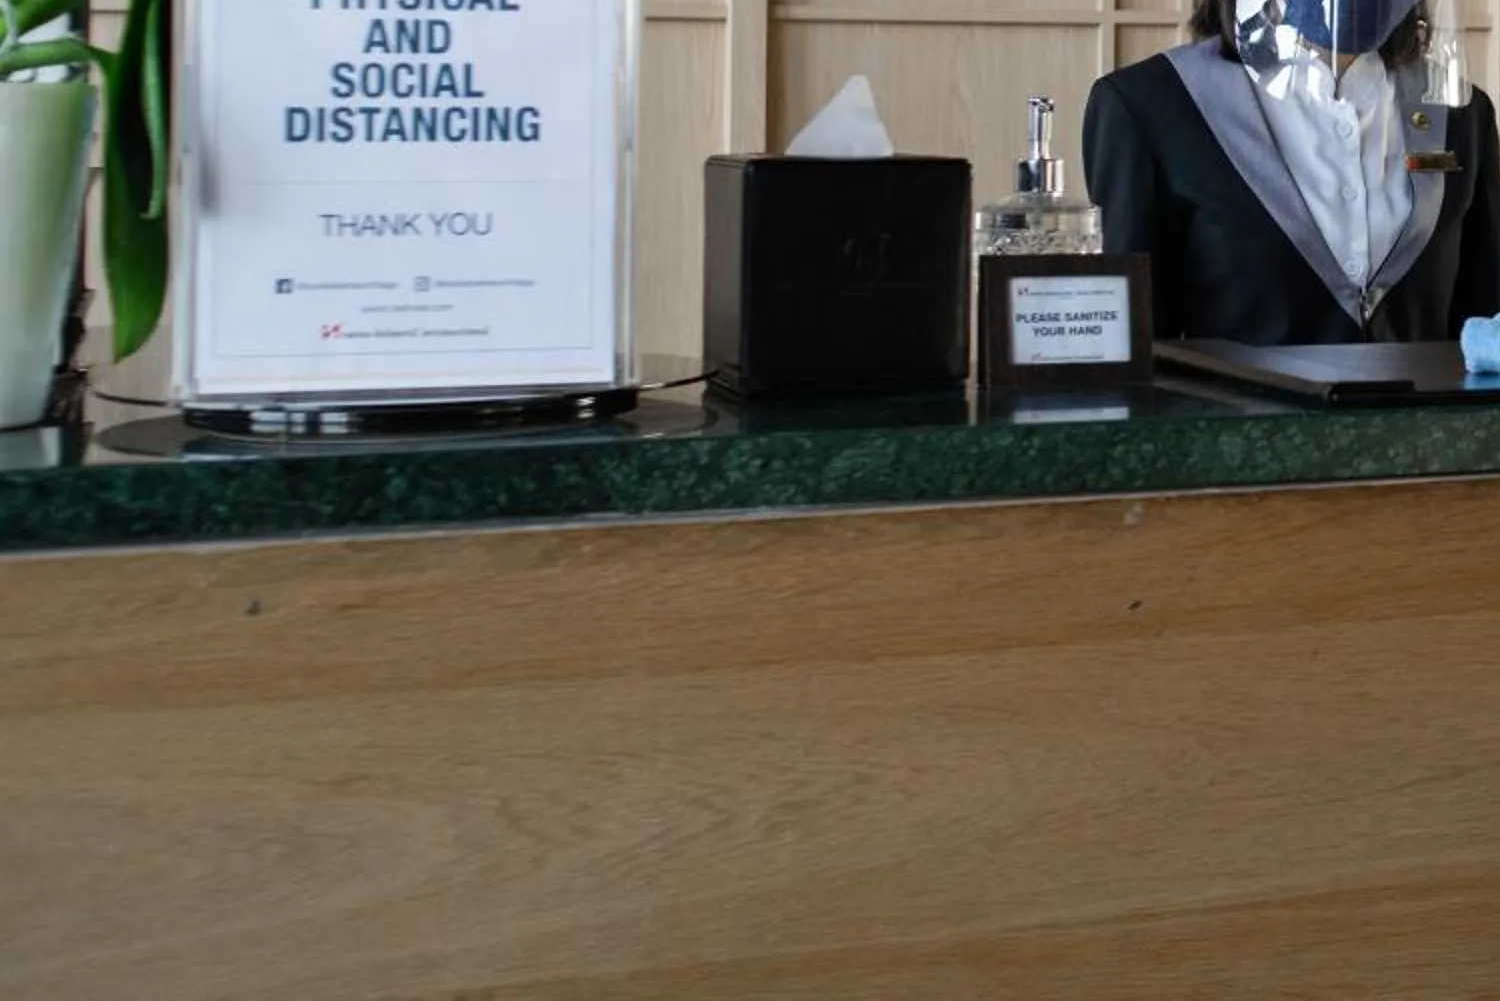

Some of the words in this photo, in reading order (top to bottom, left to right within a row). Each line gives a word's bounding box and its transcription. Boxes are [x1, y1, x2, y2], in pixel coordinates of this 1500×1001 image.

[362, 18, 452, 55] AND
[330, 62, 485, 99] SOCIAL
[284, 106, 541, 144] DISTANCING
[319, 213, 421, 237] THANK
[428, 211, 493, 236] YOU
[1015, 312, 1061, 324] PLEASE
[1064, 310, 1119, 322] SANITIZE
[1033, 326, 1066, 338] YOUR
[1068, 324, 1103, 337] HAND
